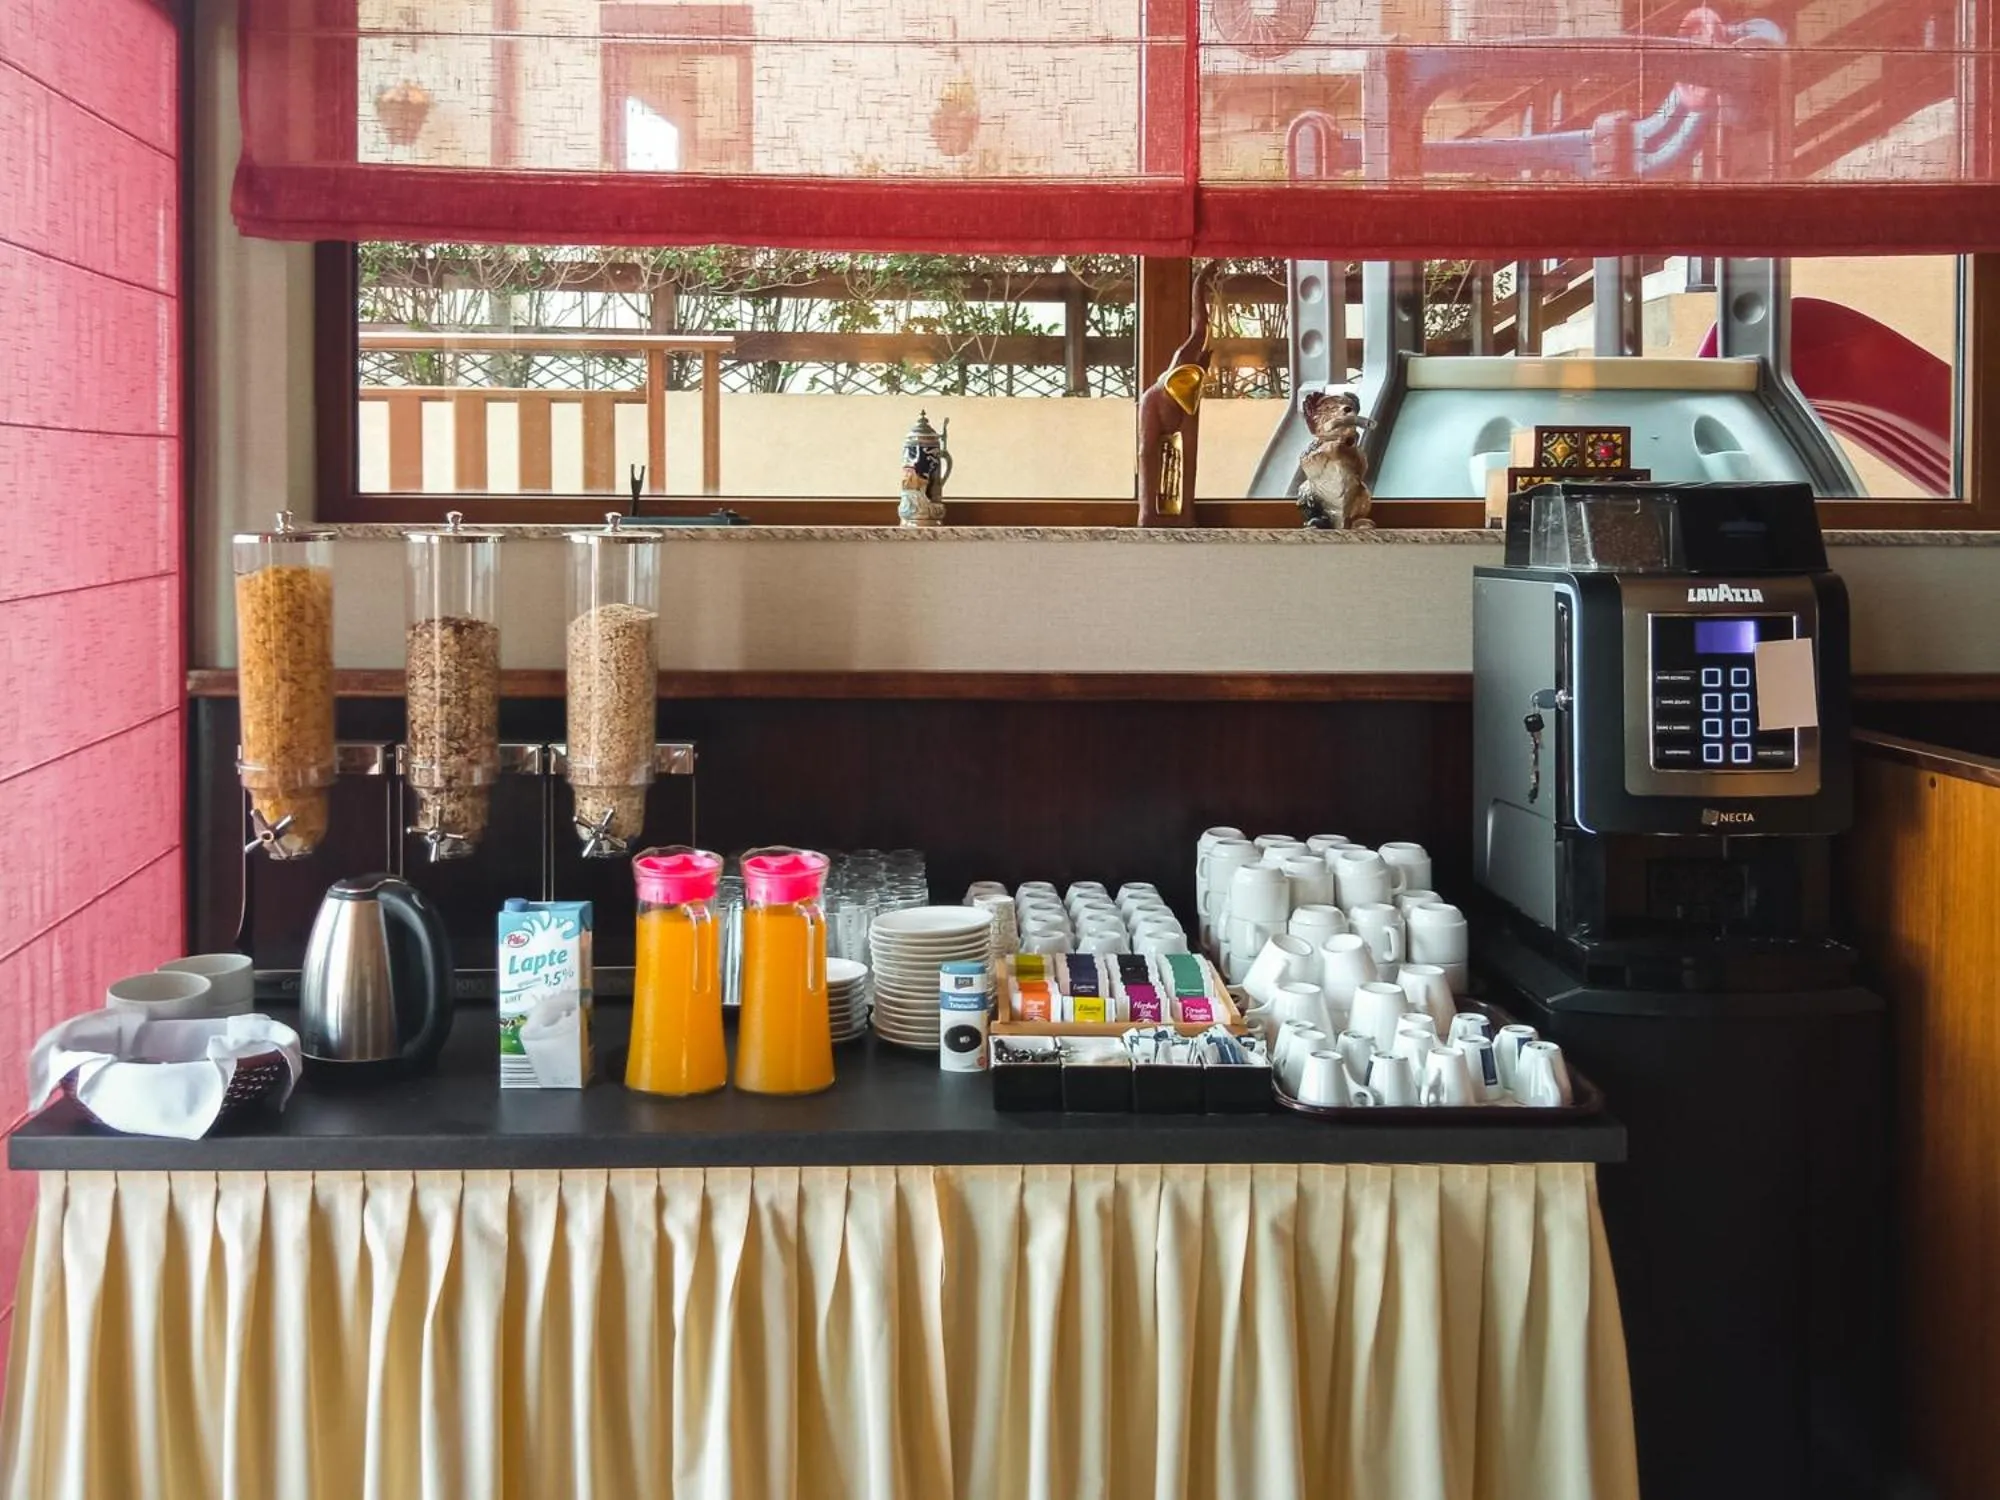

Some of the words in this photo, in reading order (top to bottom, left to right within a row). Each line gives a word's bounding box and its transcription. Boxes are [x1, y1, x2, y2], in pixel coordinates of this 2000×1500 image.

[1687, 583, 1765, 603] LAVAZZA
[1720, 812, 1755, 822] NECTA
[508, 949, 568, 975] Lapte
